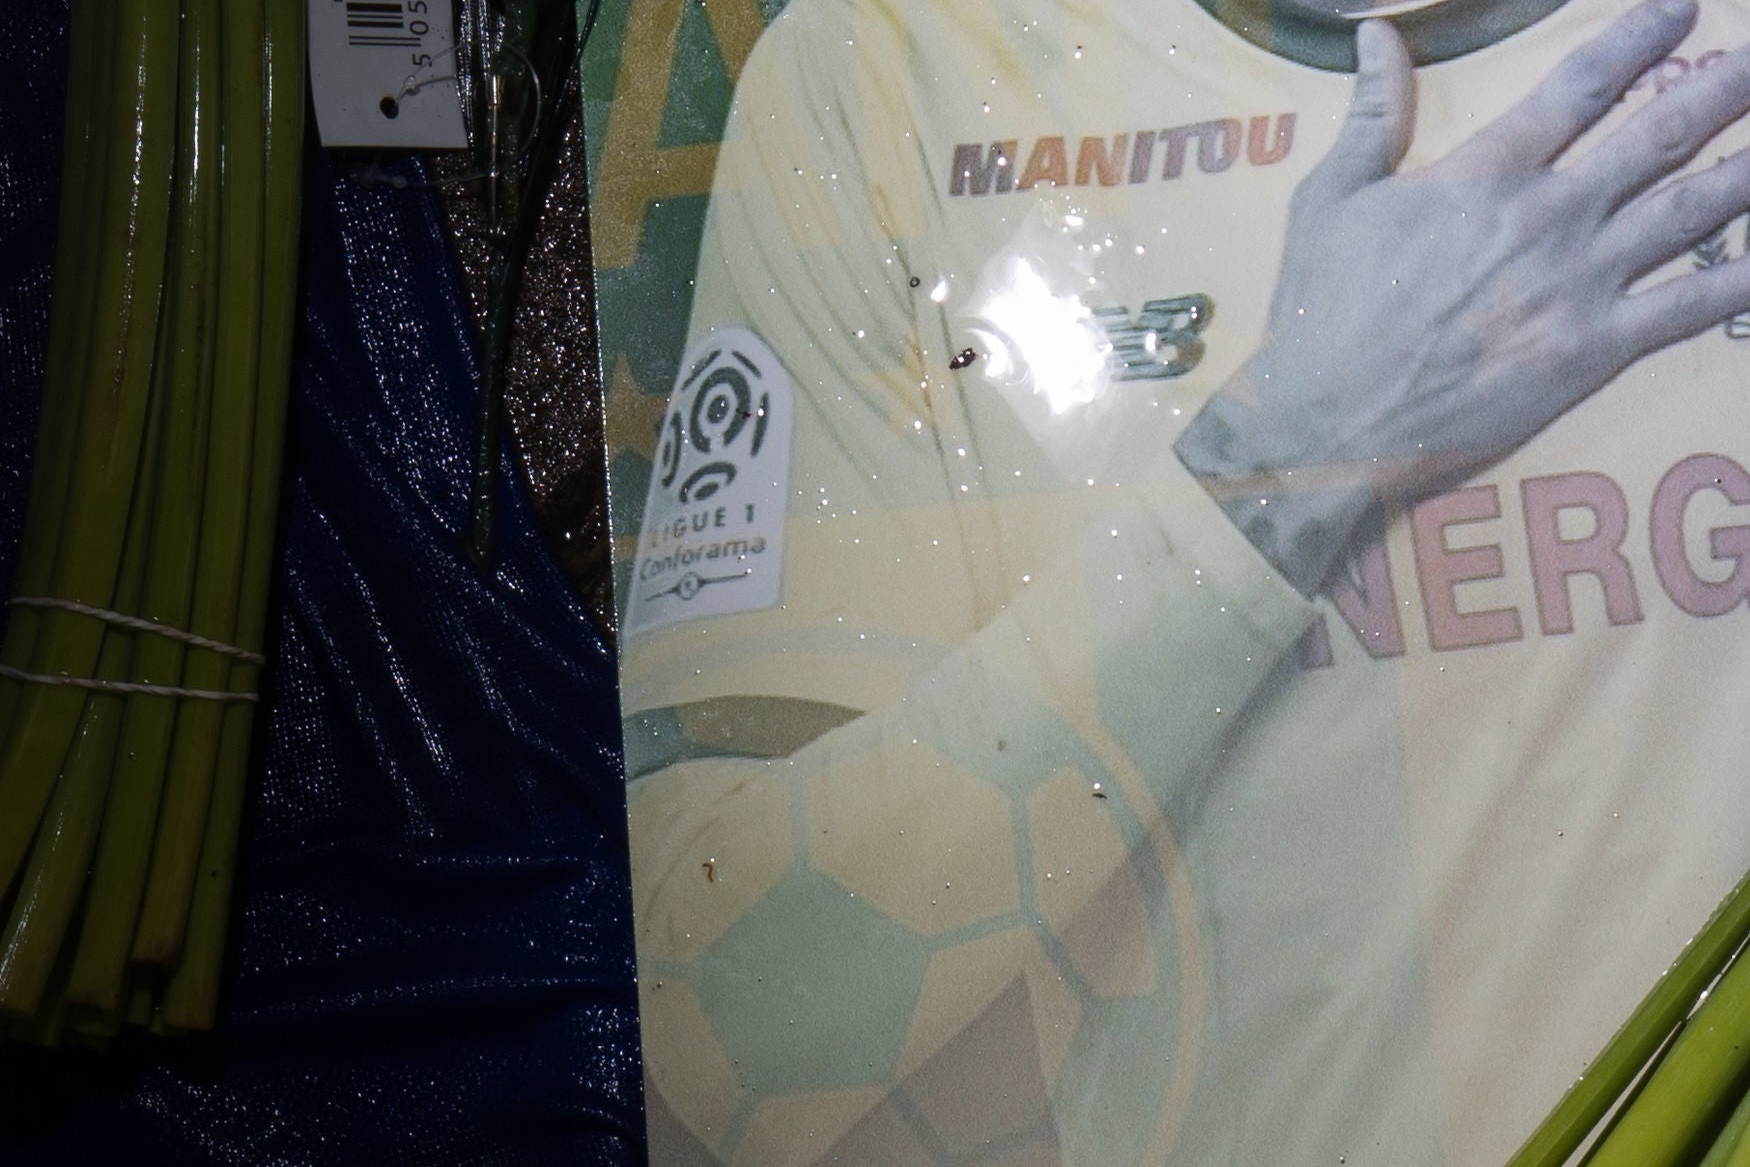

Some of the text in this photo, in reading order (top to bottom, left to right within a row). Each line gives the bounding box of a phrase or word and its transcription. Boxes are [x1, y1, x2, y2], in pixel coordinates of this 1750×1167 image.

[948, 112, 1297, 197] MANITOU
[744, 503, 755, 524] 1
[640, 536, 767, 582] Conforama
